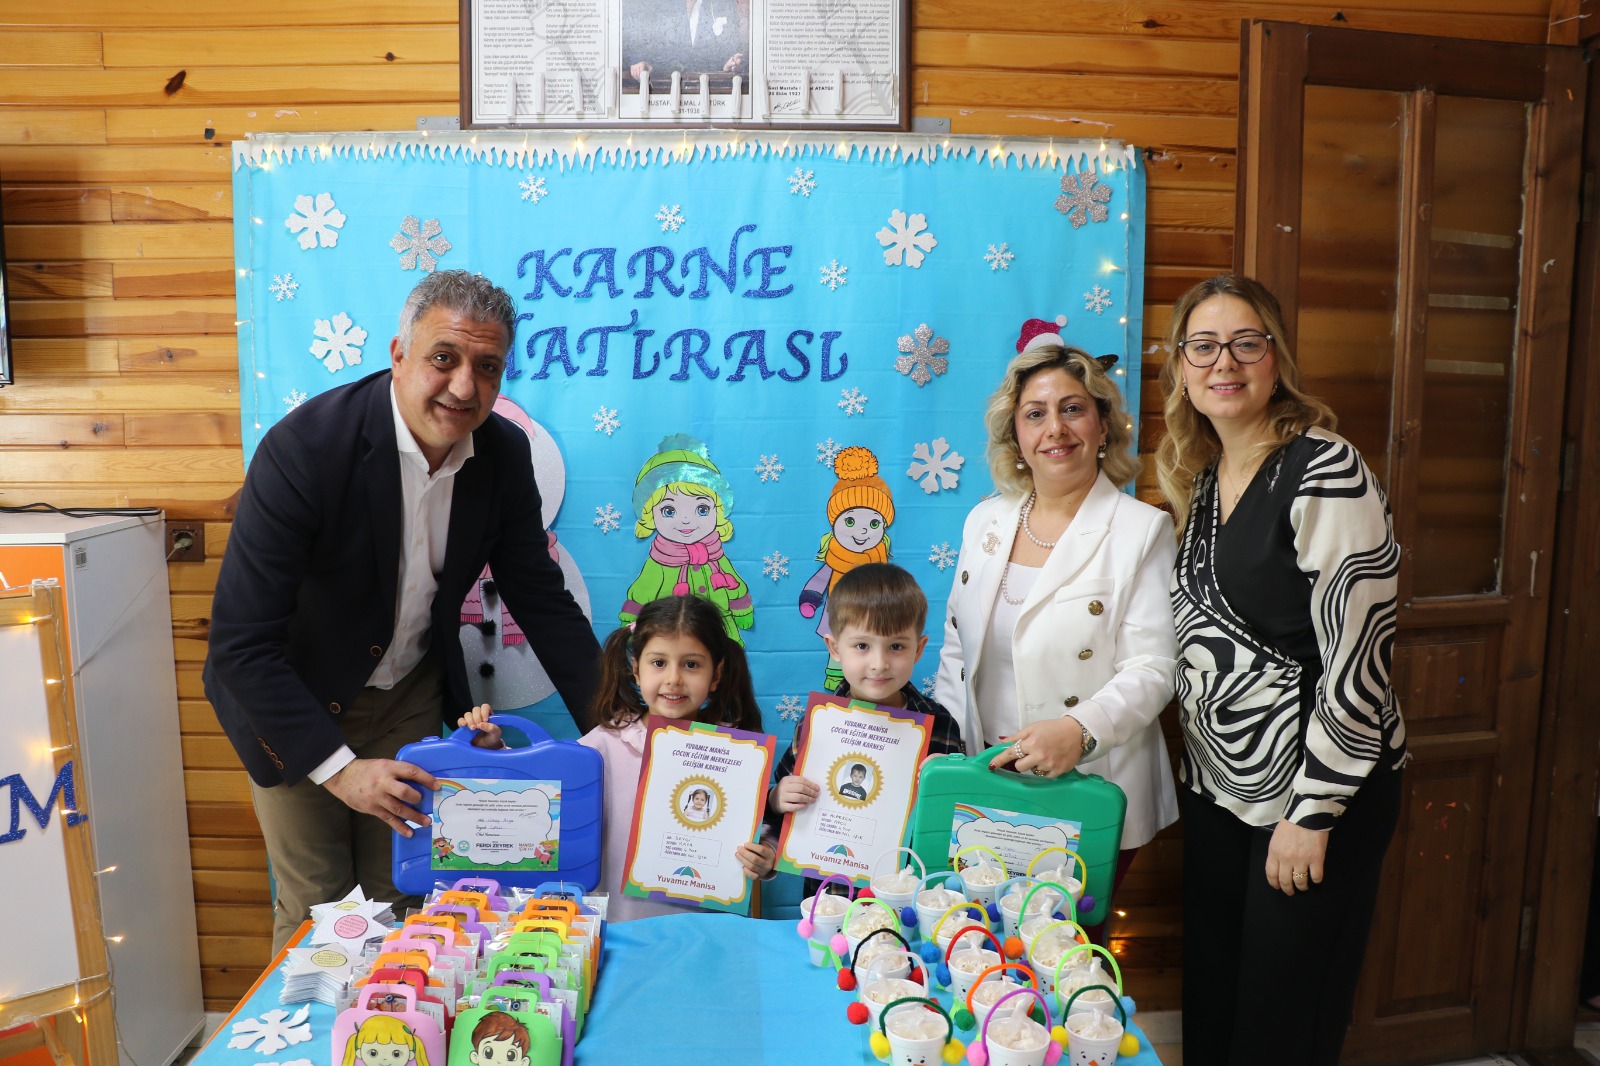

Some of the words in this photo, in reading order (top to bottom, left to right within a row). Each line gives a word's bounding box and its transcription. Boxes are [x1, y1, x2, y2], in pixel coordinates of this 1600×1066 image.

[517, 223, 794, 301] KARNE
[831, 726, 849, 735] ÇOCUK
[849, 728, 868, 739] EĞİTİM
[868, 733, 901, 745] MERKEZLERİ
[844, 720, 867, 730] YUVAMIZ
[867, 724, 889, 734] MANİSA
[685, 743, 709, 752] YUVAMIZ
[709, 747, 730, 756] MANİSA
[840, 736, 862, 747] GELİŞİM
[862, 741, 886, 751] KARNESİ
[672, 749, 691, 758] ÇOCUK
[691, 751, 710, 761] EĞİTİM
[710, 756, 743, 767] MERKEZLERİ
[811, 851, 842, 866] Yuvamız
[843, 857, 869, 871] Manisa
[657, 874, 688, 888] Yuvamız
[690, 877, 716, 892] Manisa
